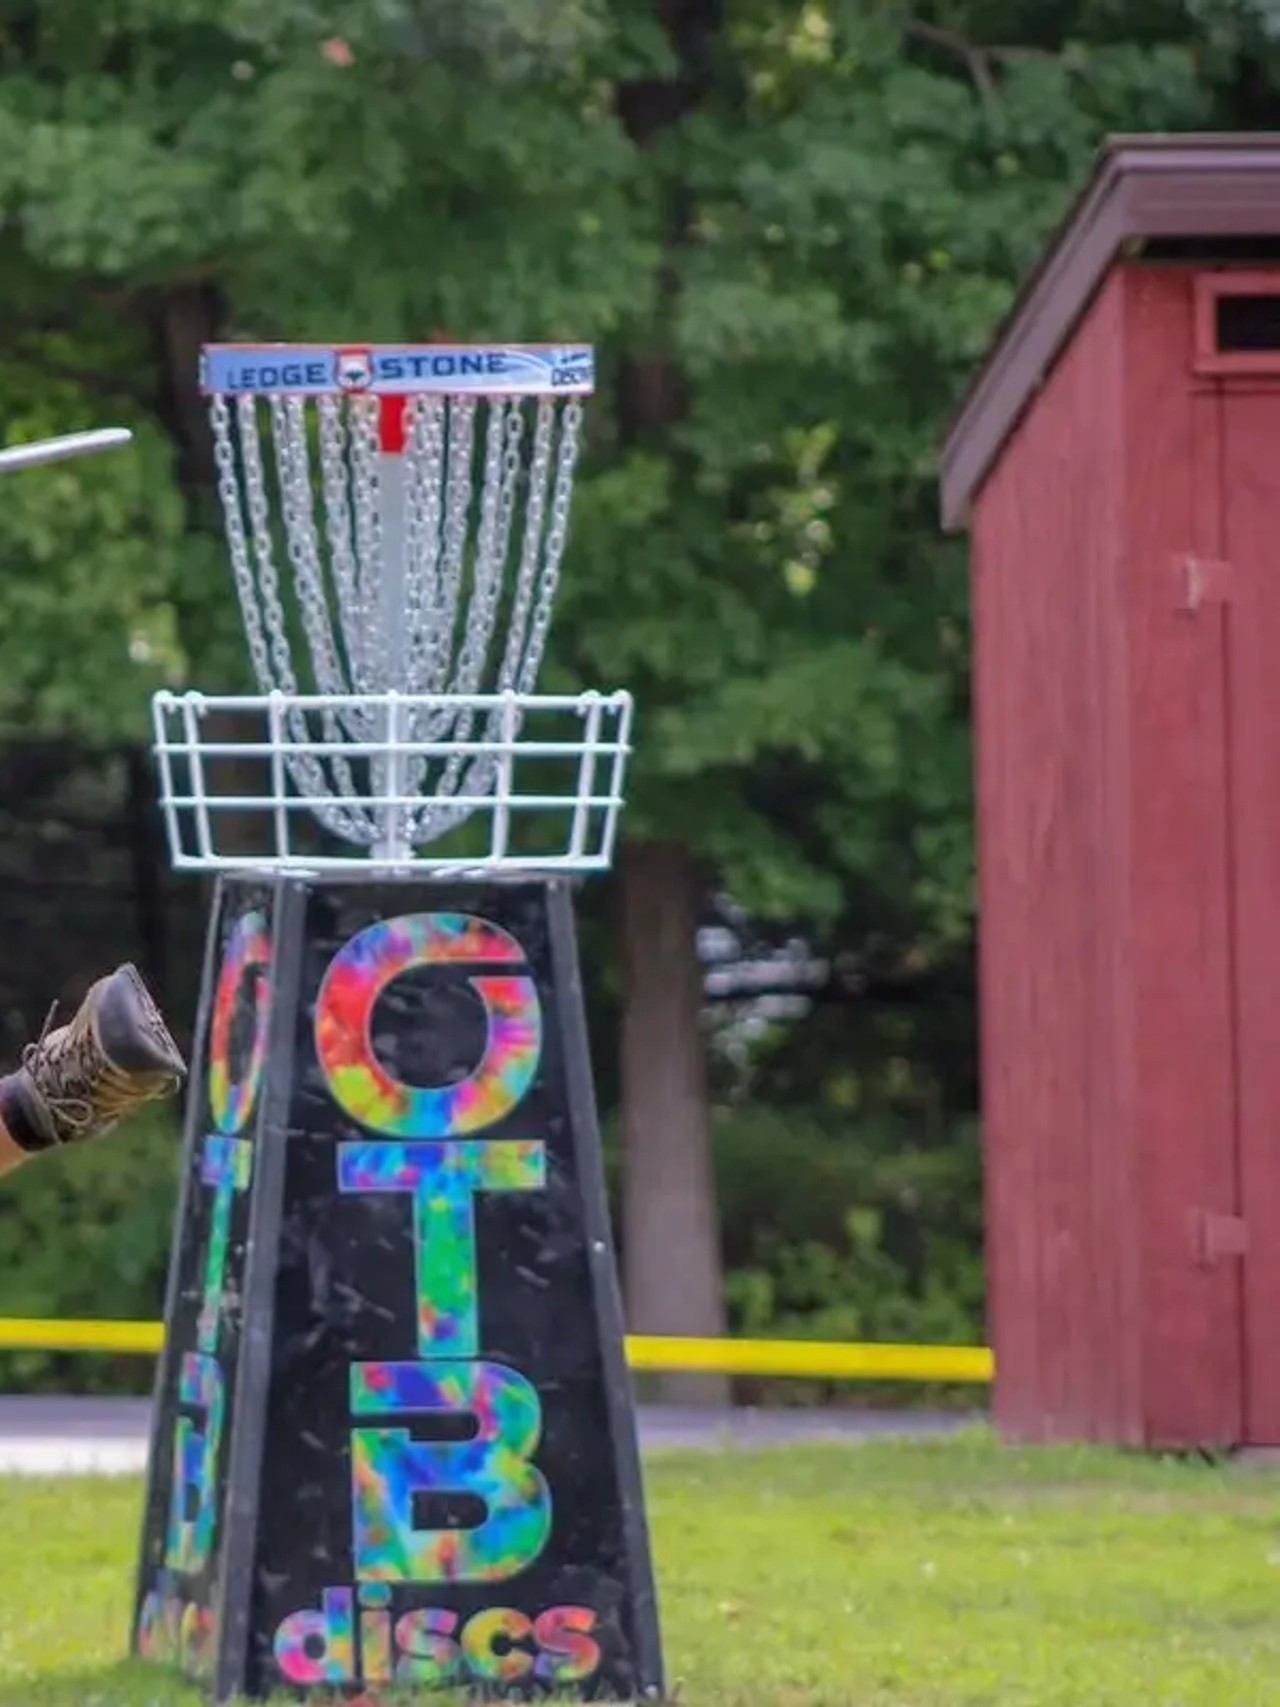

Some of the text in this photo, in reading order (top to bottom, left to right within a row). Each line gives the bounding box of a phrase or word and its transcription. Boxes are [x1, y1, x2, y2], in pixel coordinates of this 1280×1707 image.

[227, 351, 507, 390] LEDGE STONE
[273, 1585, 602, 1684] discs
